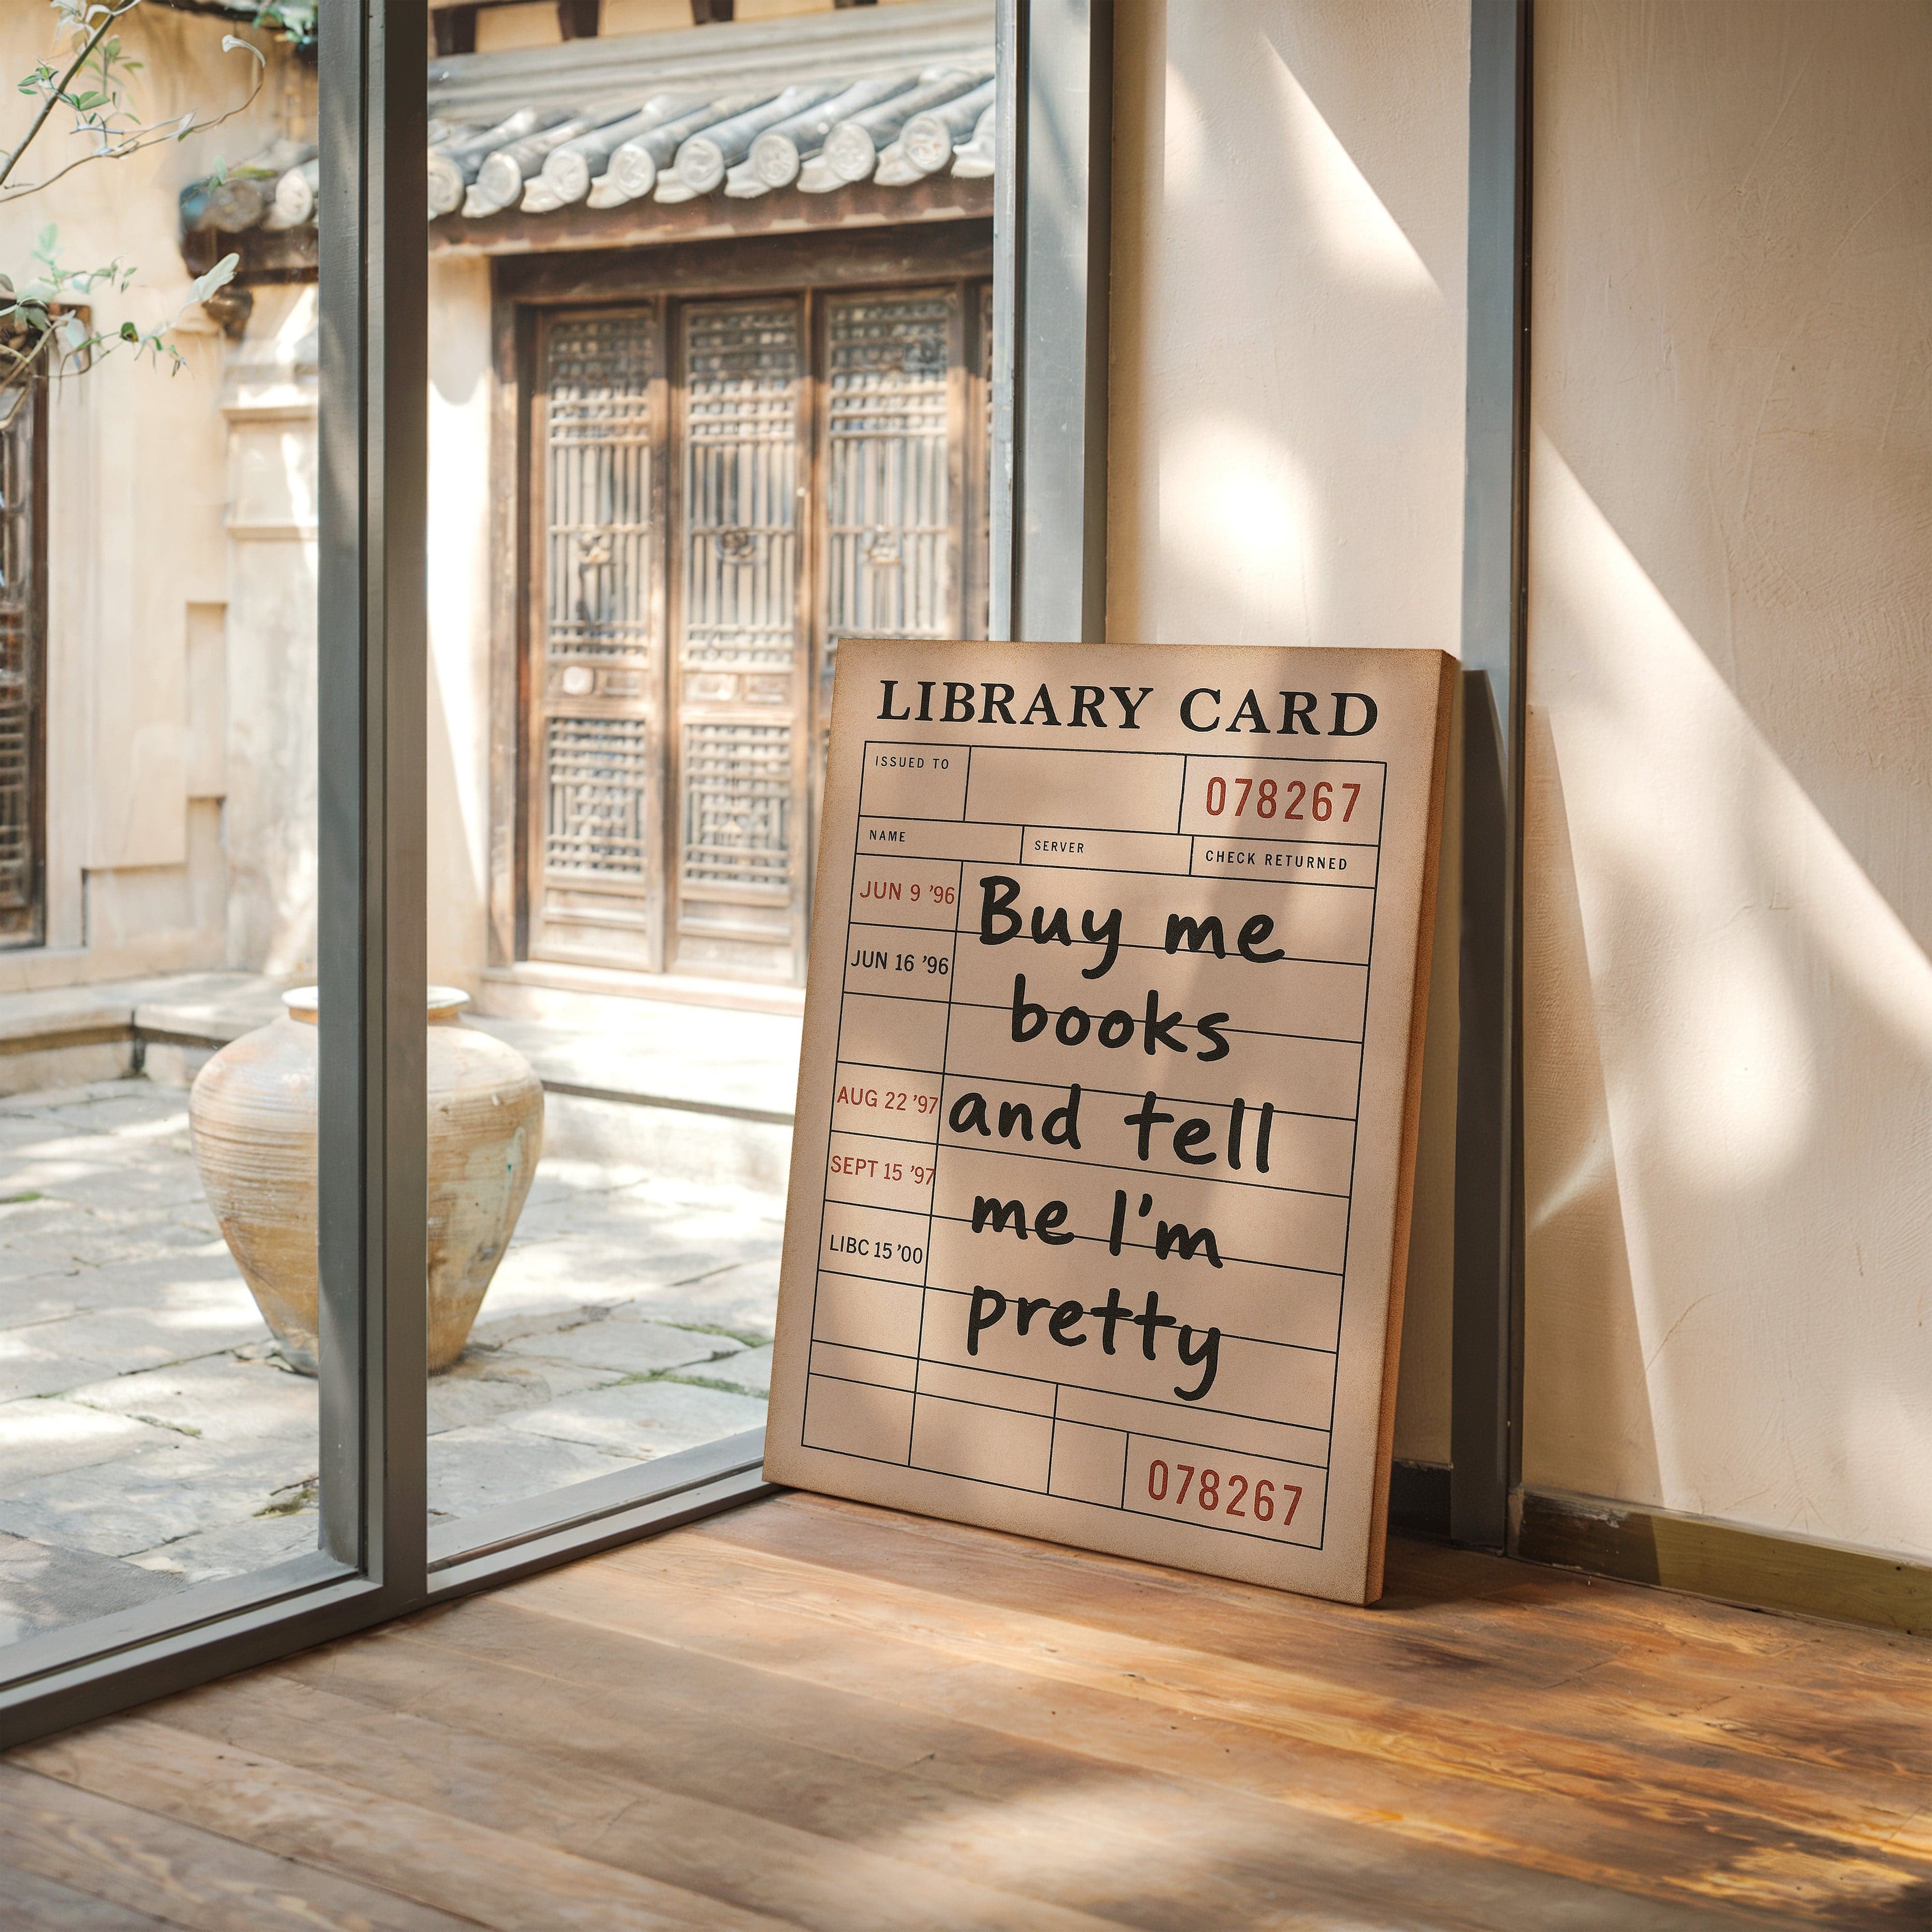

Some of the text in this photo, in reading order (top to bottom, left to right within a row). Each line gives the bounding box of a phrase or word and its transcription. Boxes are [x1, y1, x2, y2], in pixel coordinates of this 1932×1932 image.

[877, 680, 1377, 736] LIBRARY CARD
[874, 756, 948, 769] ISSUED TO
[1207, 776, 1360, 821] 078267
[870, 830, 905, 842] NAME
[1035, 841, 1083, 853] SERVER
[1206, 850, 1346, 870] CHECK RETURNED
[860, 881, 901, 900] JUN
[910, 884, 920, 902] 9
[979, 876, 1284, 979] Buy me
[851, 950, 887, 969] JUN
[896, 954, 914, 972] 16
[1011, 973, 1231, 1063] books
[837, 1086, 877, 1108] AUG
[884, 1091, 907, 1111] 22
[949, 1084, 1274, 1173] and tell
[831, 1155, 878, 1178] SEPT
[883, 1163, 902, 1181] 15
[972, 1196, 1075, 1245] me
[830, 1234, 869, 1256] LIBC
[874, 1242, 892, 1259] 15
[968, 1285, 1221, 1401] pretty
[1148, 1460, 1301, 1524] 078267
